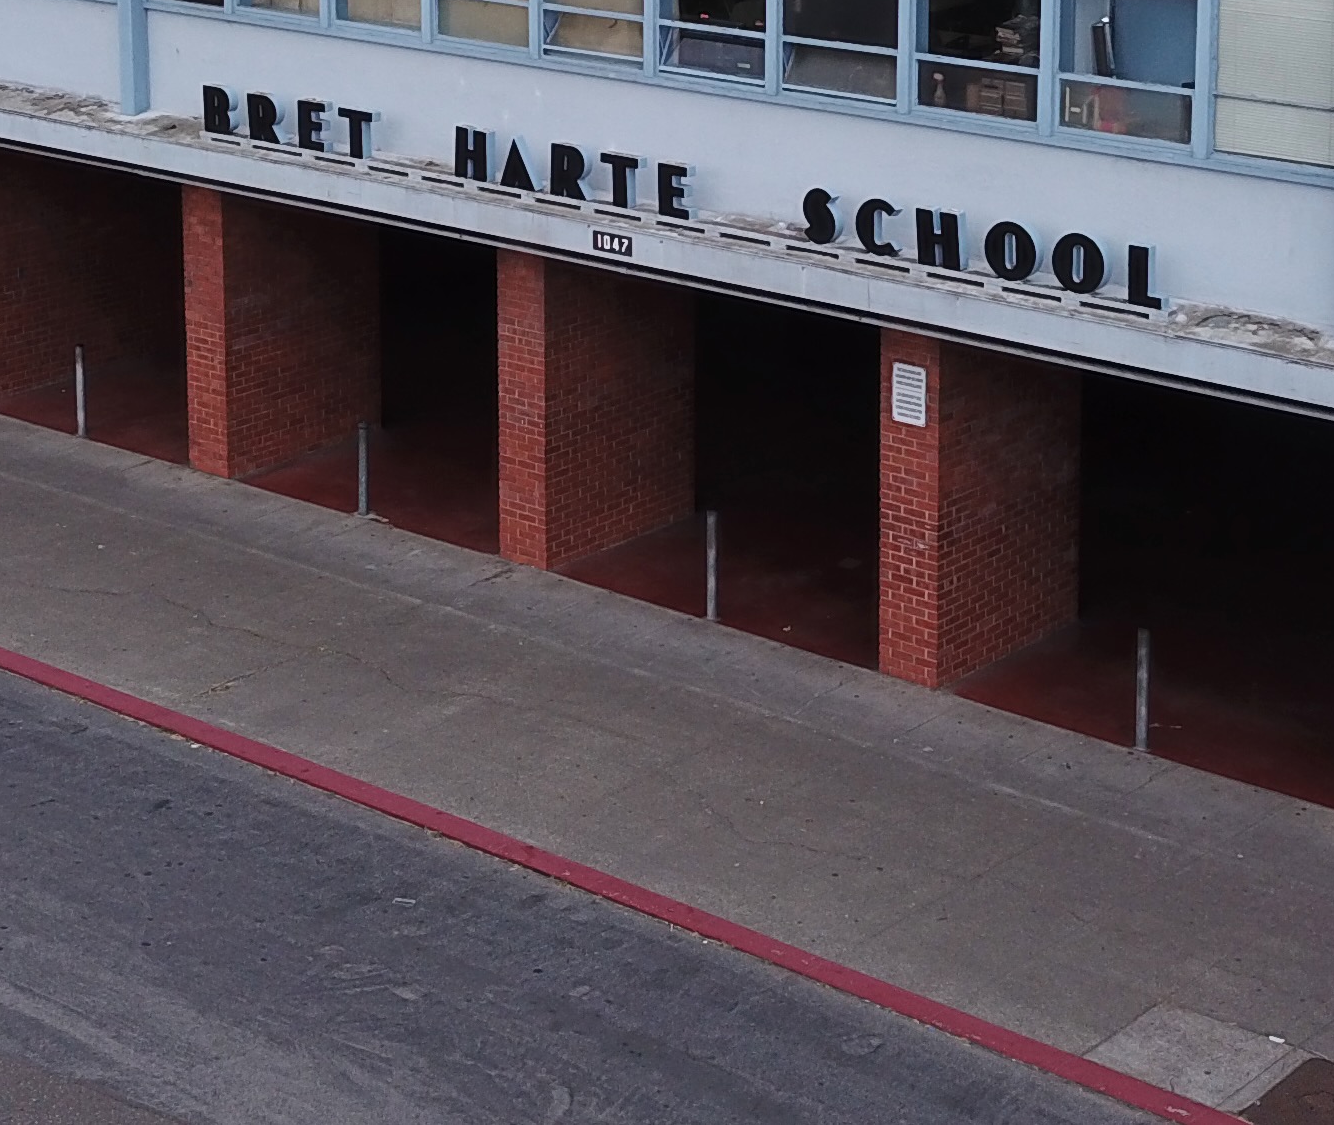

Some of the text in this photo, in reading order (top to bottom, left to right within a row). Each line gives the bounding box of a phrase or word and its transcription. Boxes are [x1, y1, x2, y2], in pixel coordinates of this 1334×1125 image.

[202, 83, 1167, 310] BRET HARTE SCHOOL
[597, 233, 629, 253] 1047
